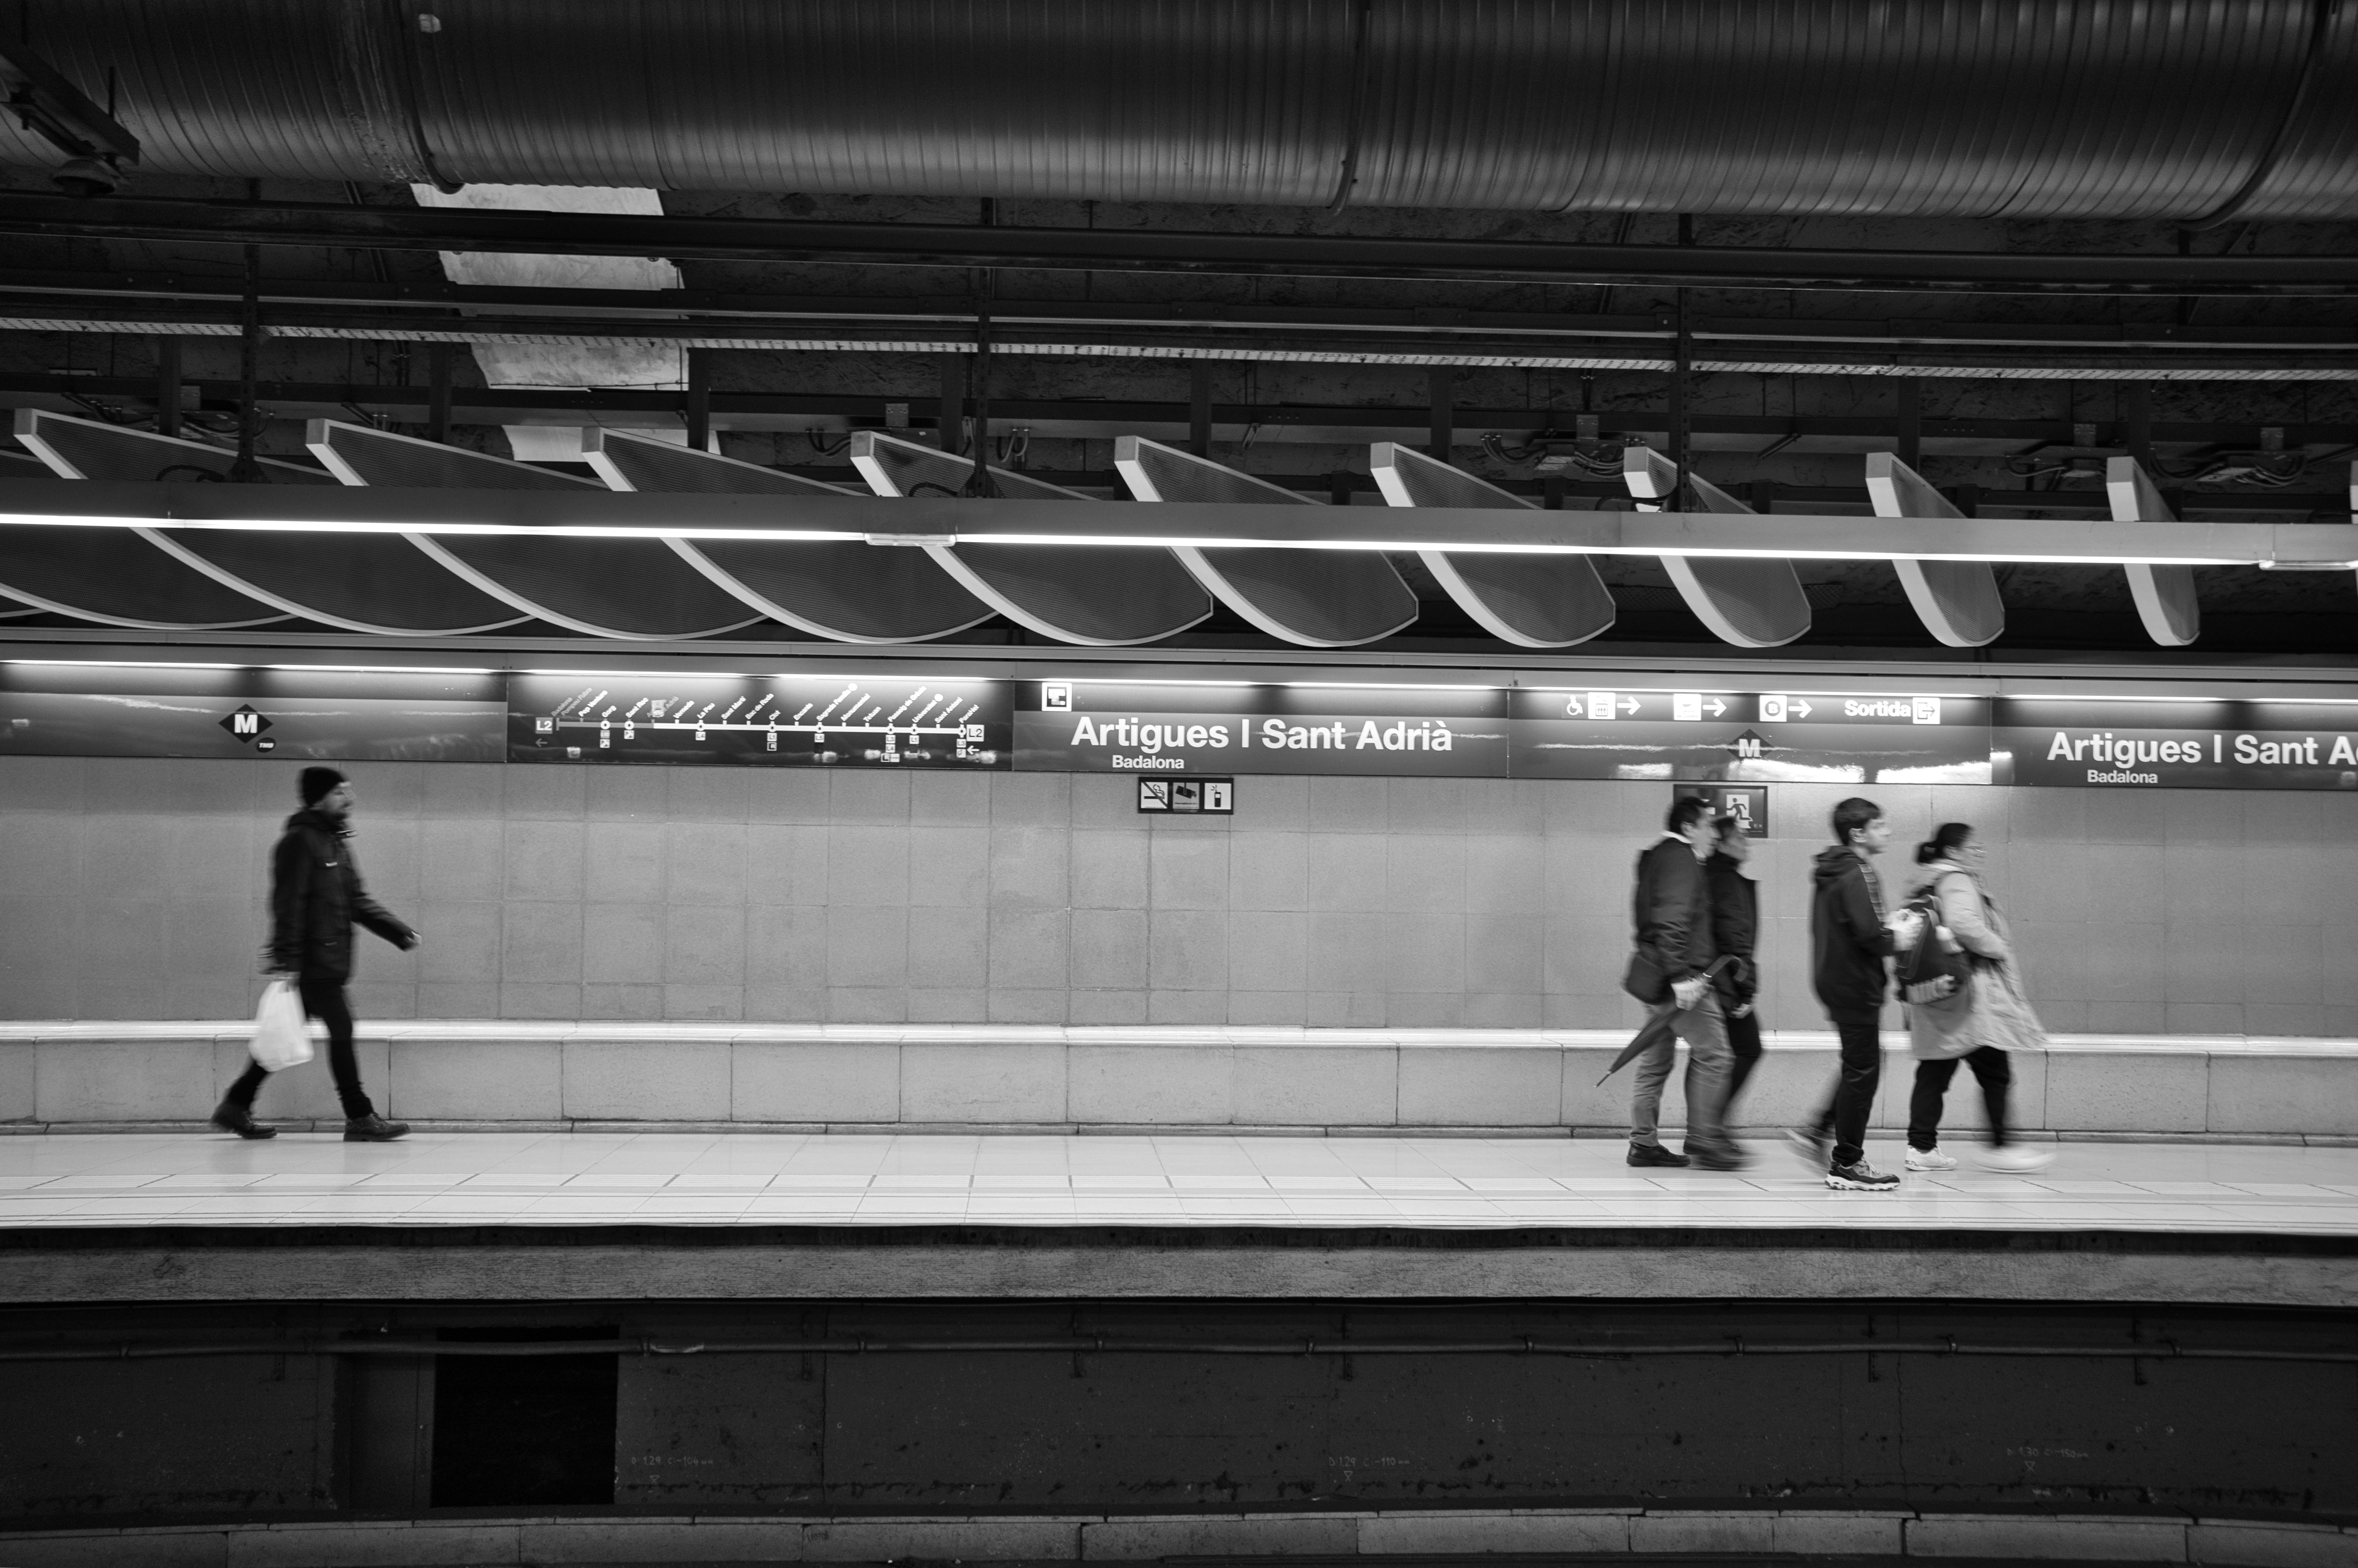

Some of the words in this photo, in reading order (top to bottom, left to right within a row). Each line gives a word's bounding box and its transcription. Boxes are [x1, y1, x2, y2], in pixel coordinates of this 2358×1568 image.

[1769, 704, 1778, 714] B
[1845, 700, 1911, 717] Sortida
[234, 715, 257, 733] M
[537, 720, 552, 731] L2
[969, 728, 982, 738] L2
[1071, 717, 1229, 753] Artigues
[1261, 719, 1346, 749] Sant
[1355, 720, 1453, 751] Adrià
[1739, 739, 1760, 757] M
[2047, 732, 2202, 769] Artigues
[2234, 734, 2319, 764] Sant
[2328, 736, 2358, 764] A
[1112, 755, 1184, 769] Badalona
[2087, 770, 2158, 783] Badalona
